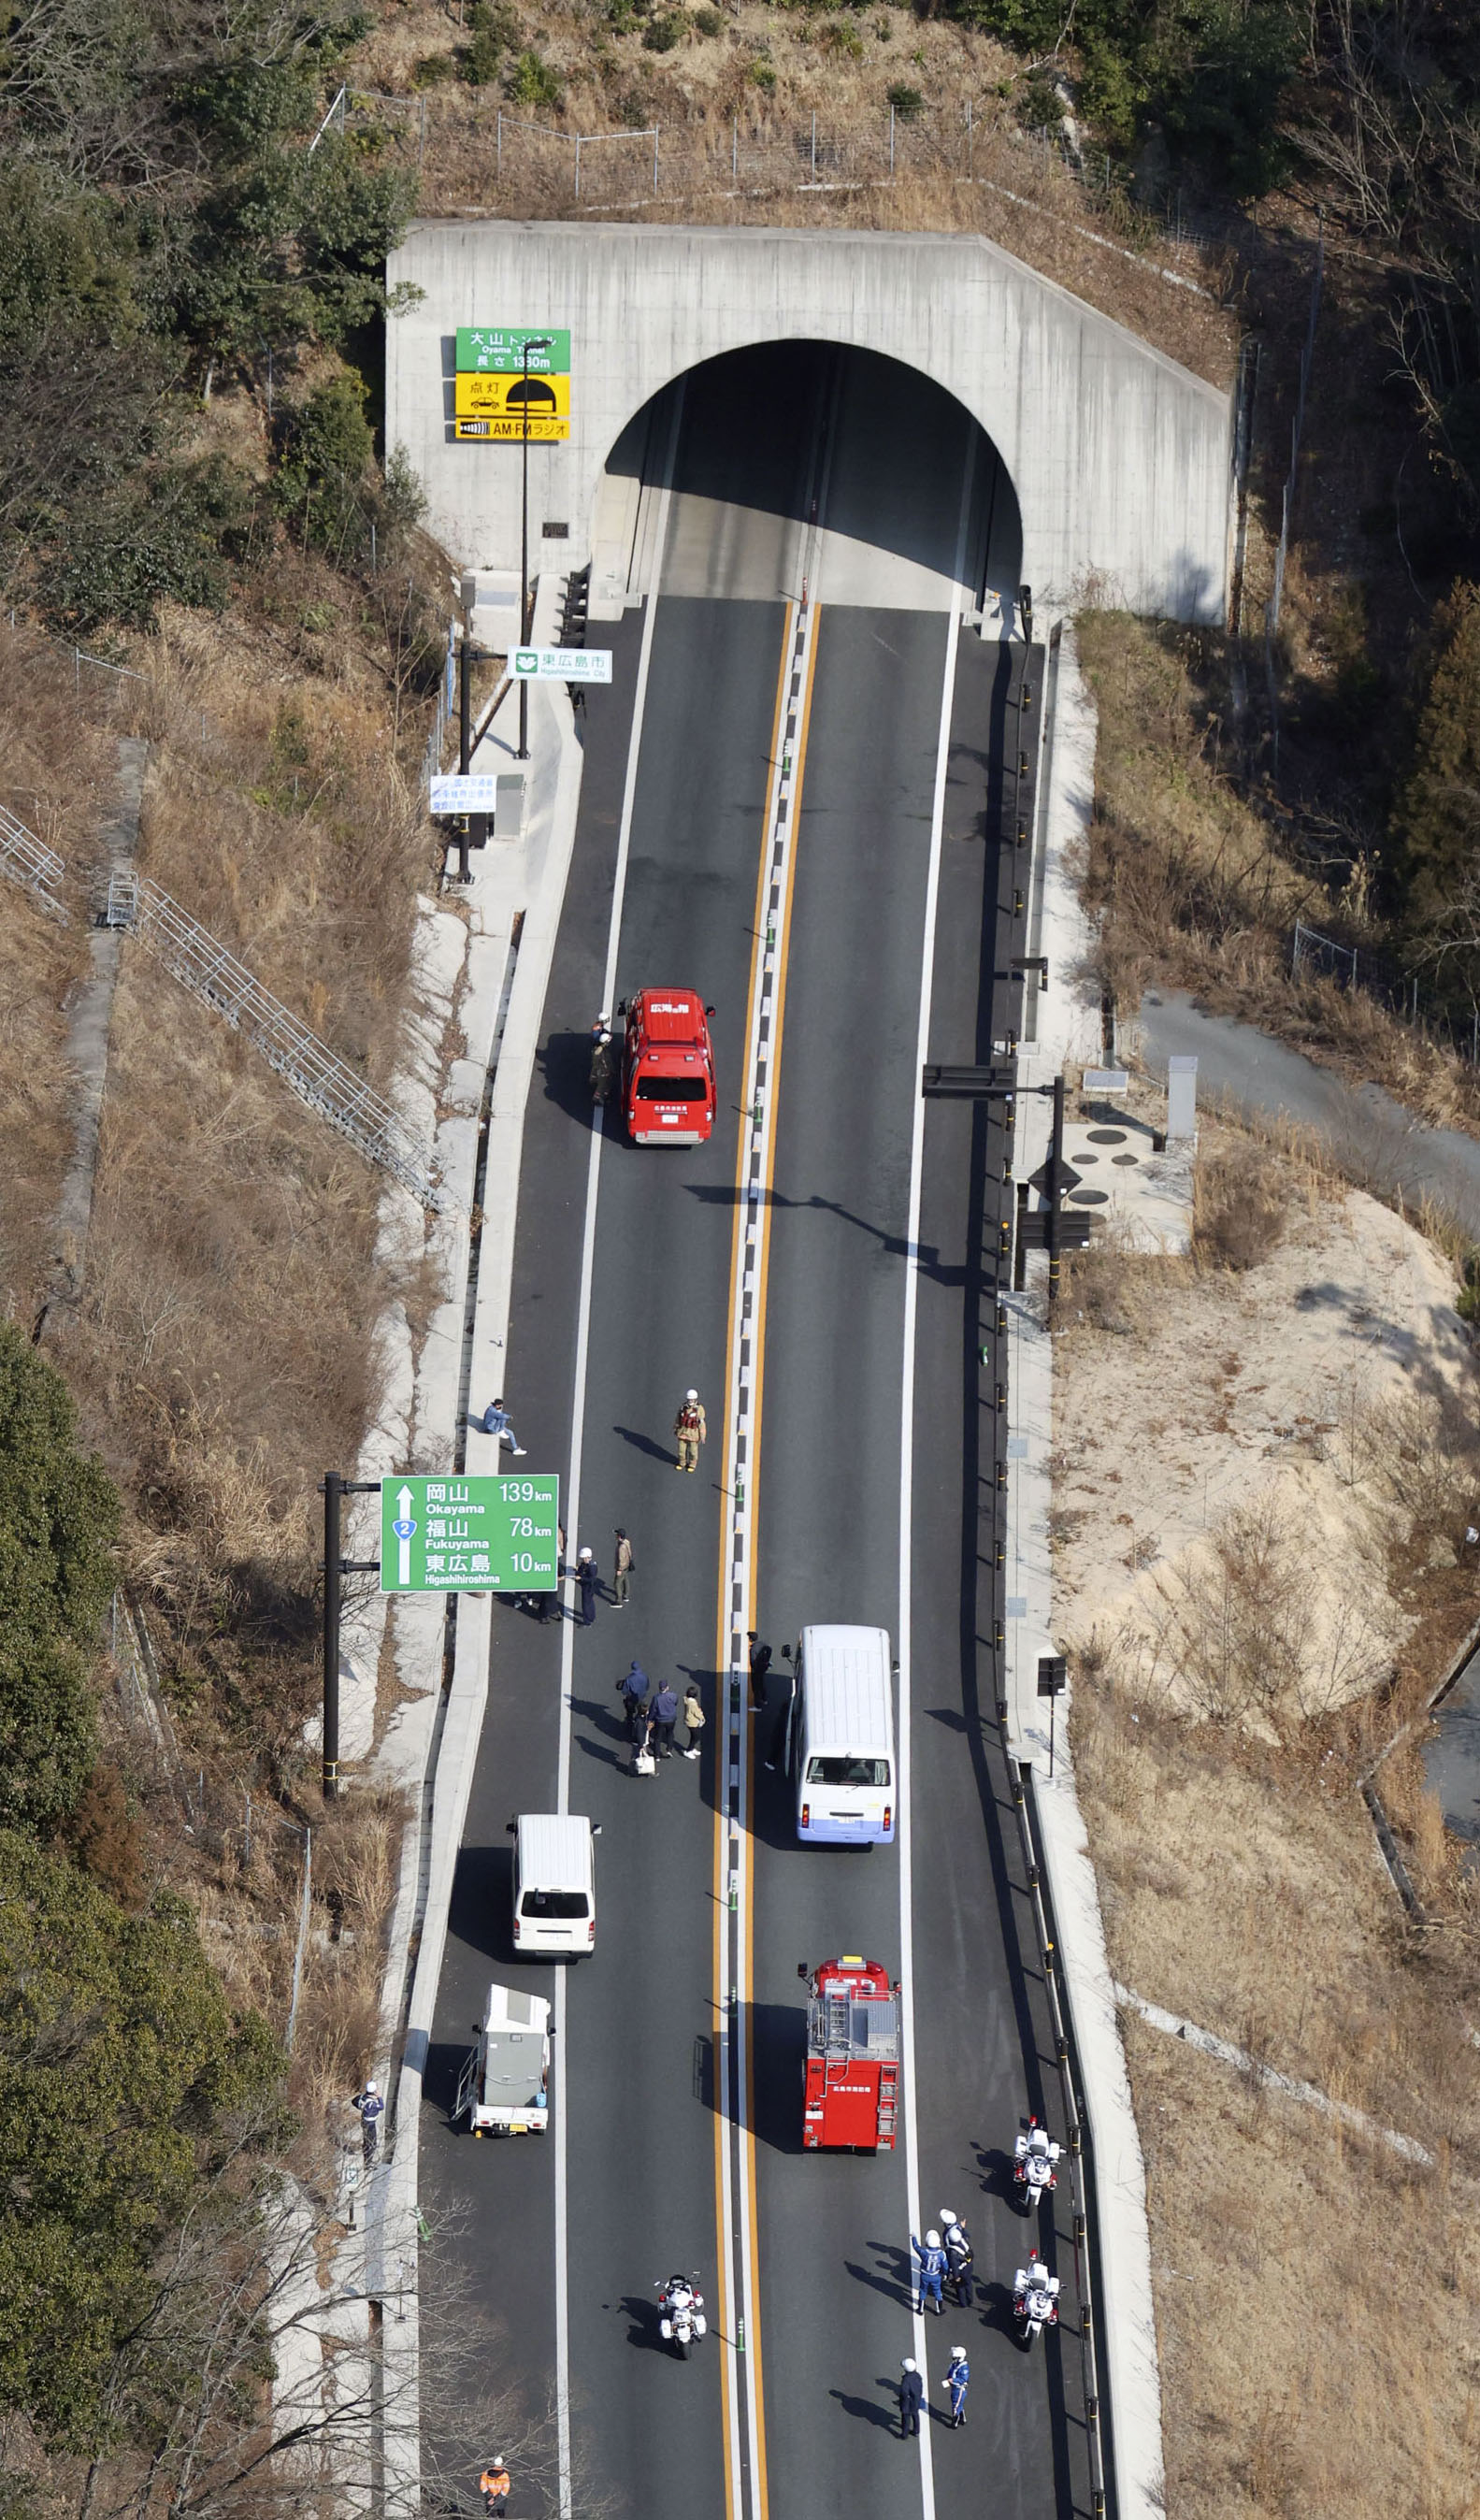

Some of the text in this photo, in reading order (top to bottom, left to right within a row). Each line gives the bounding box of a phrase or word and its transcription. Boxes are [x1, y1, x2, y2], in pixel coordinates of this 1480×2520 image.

[481, 346, 545, 354] Oyama Tnnel
[470, 382, 499, 394] 点灯
[542, 655, 605, 668] 東広島市
[426, 1483, 468, 1503] 岡山
[425, 1504, 485, 1516] Okayama
[400, 1522, 410, 1534] 2
[425, 1519, 468, 1538] 福山
[425, 1539, 490, 1551] Fukuyama
[425, 1554, 491, 1573] 東広島
[424, 1575, 500, 1586] Higashihiroshima
